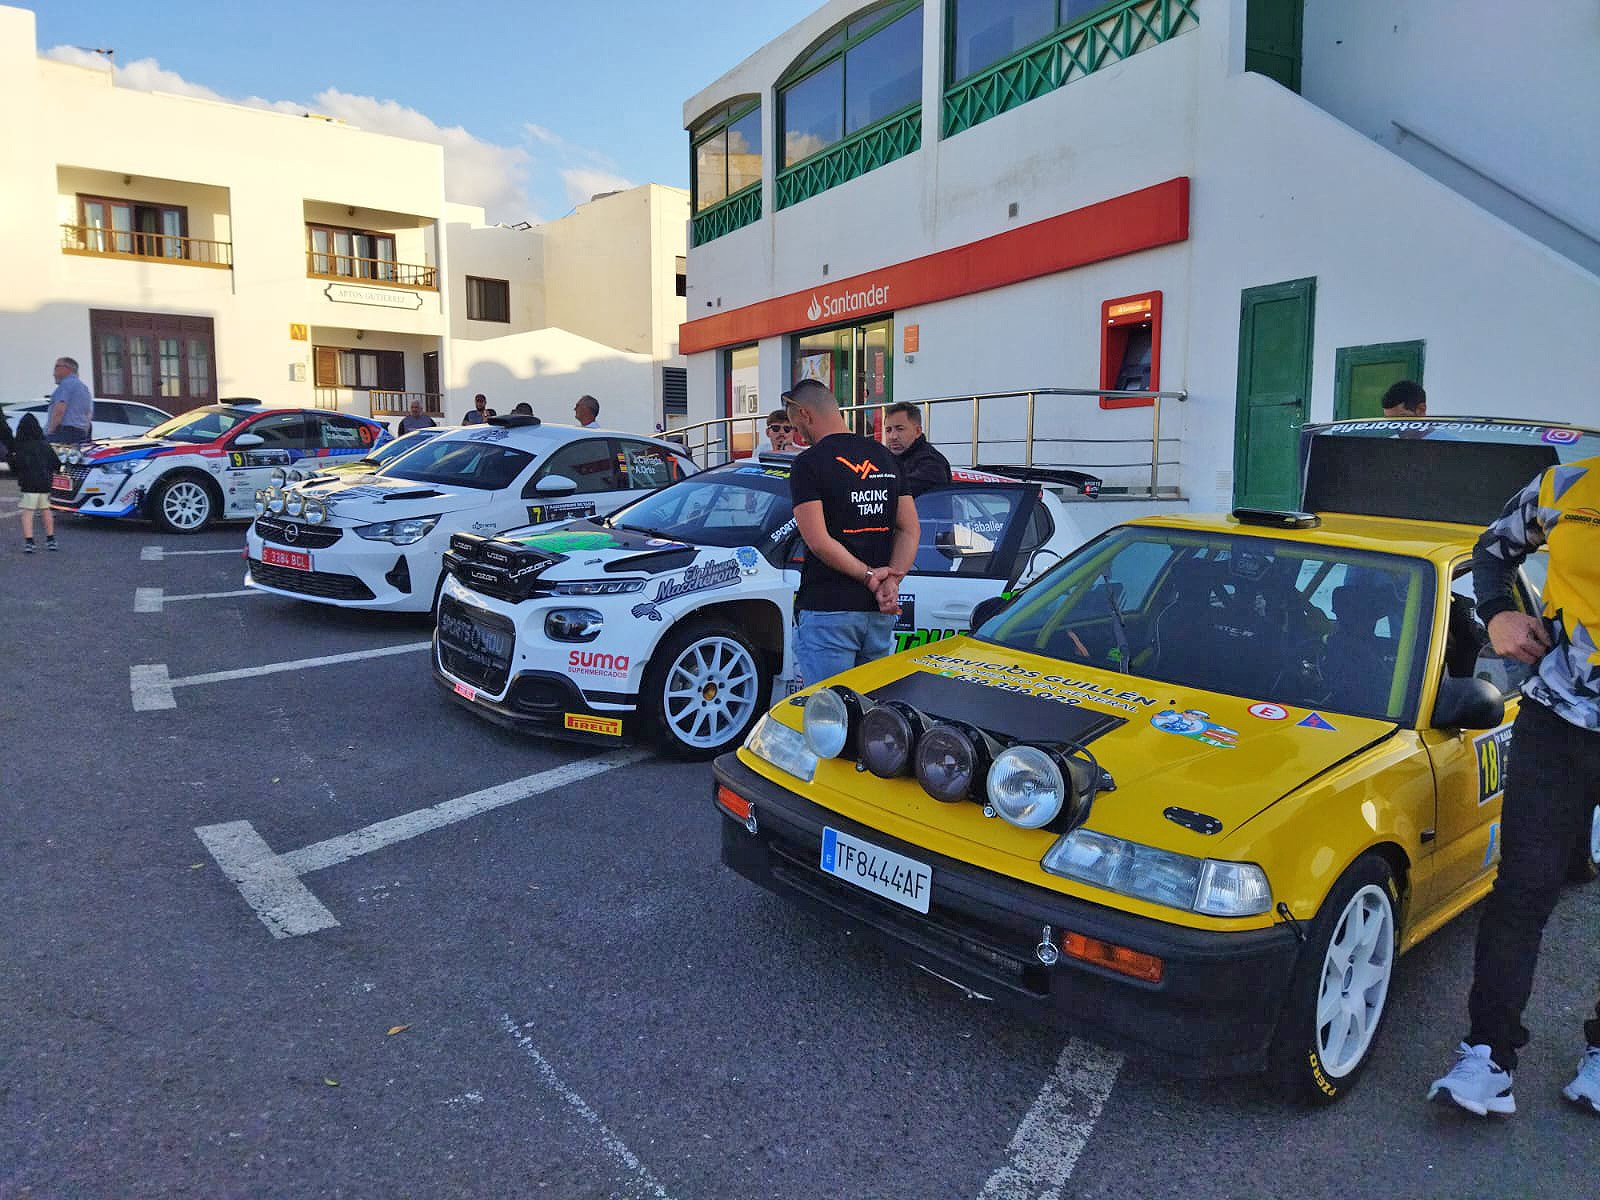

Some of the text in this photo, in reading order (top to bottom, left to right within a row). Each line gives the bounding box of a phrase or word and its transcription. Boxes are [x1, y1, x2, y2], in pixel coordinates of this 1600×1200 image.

[823, 284, 889, 318] Santander
[234, 453, 242, 467] 9
[666, 455, 678, 481] 7
[850, 489, 888, 503] RACING
[533, 507, 541, 523] 7
[857, 503, 884, 516] TEAM
[569, 650, 629, 671] suma
[922, 654, 1041, 678] SERVICIOS
[568, 667, 628, 679] SUPERMERCADOS
[1059, 688, 1138, 713] GENERAL
[1260, 707, 1275, 719] E
[567, 716, 619, 734] PIRELLI
[1481, 740, 1499, 795] 18
